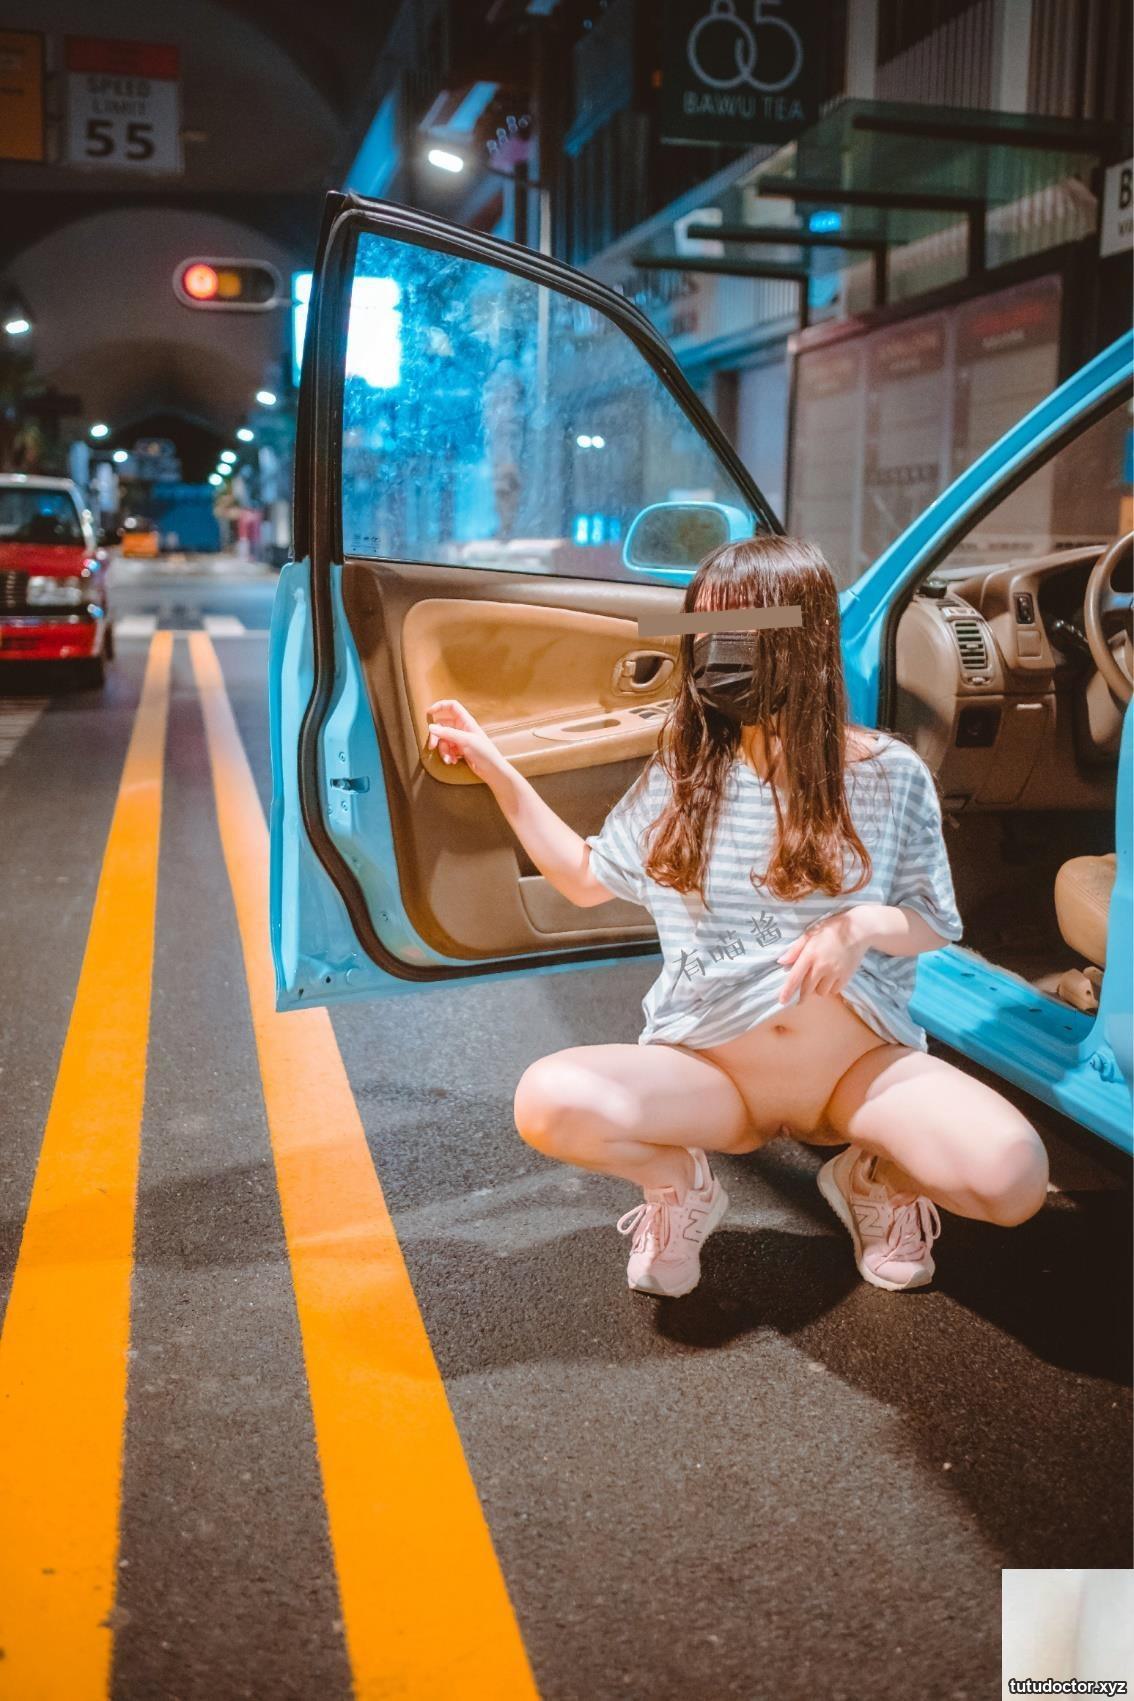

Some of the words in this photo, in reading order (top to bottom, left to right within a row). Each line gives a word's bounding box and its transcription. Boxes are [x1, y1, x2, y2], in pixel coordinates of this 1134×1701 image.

[87, 74, 151, 98] SPEED
[91, 100, 147, 117] LIMIT
[683, 91, 755, 119] BAWU
[763, 96, 805, 121] TEA
[84, 118, 155, 161] 55
